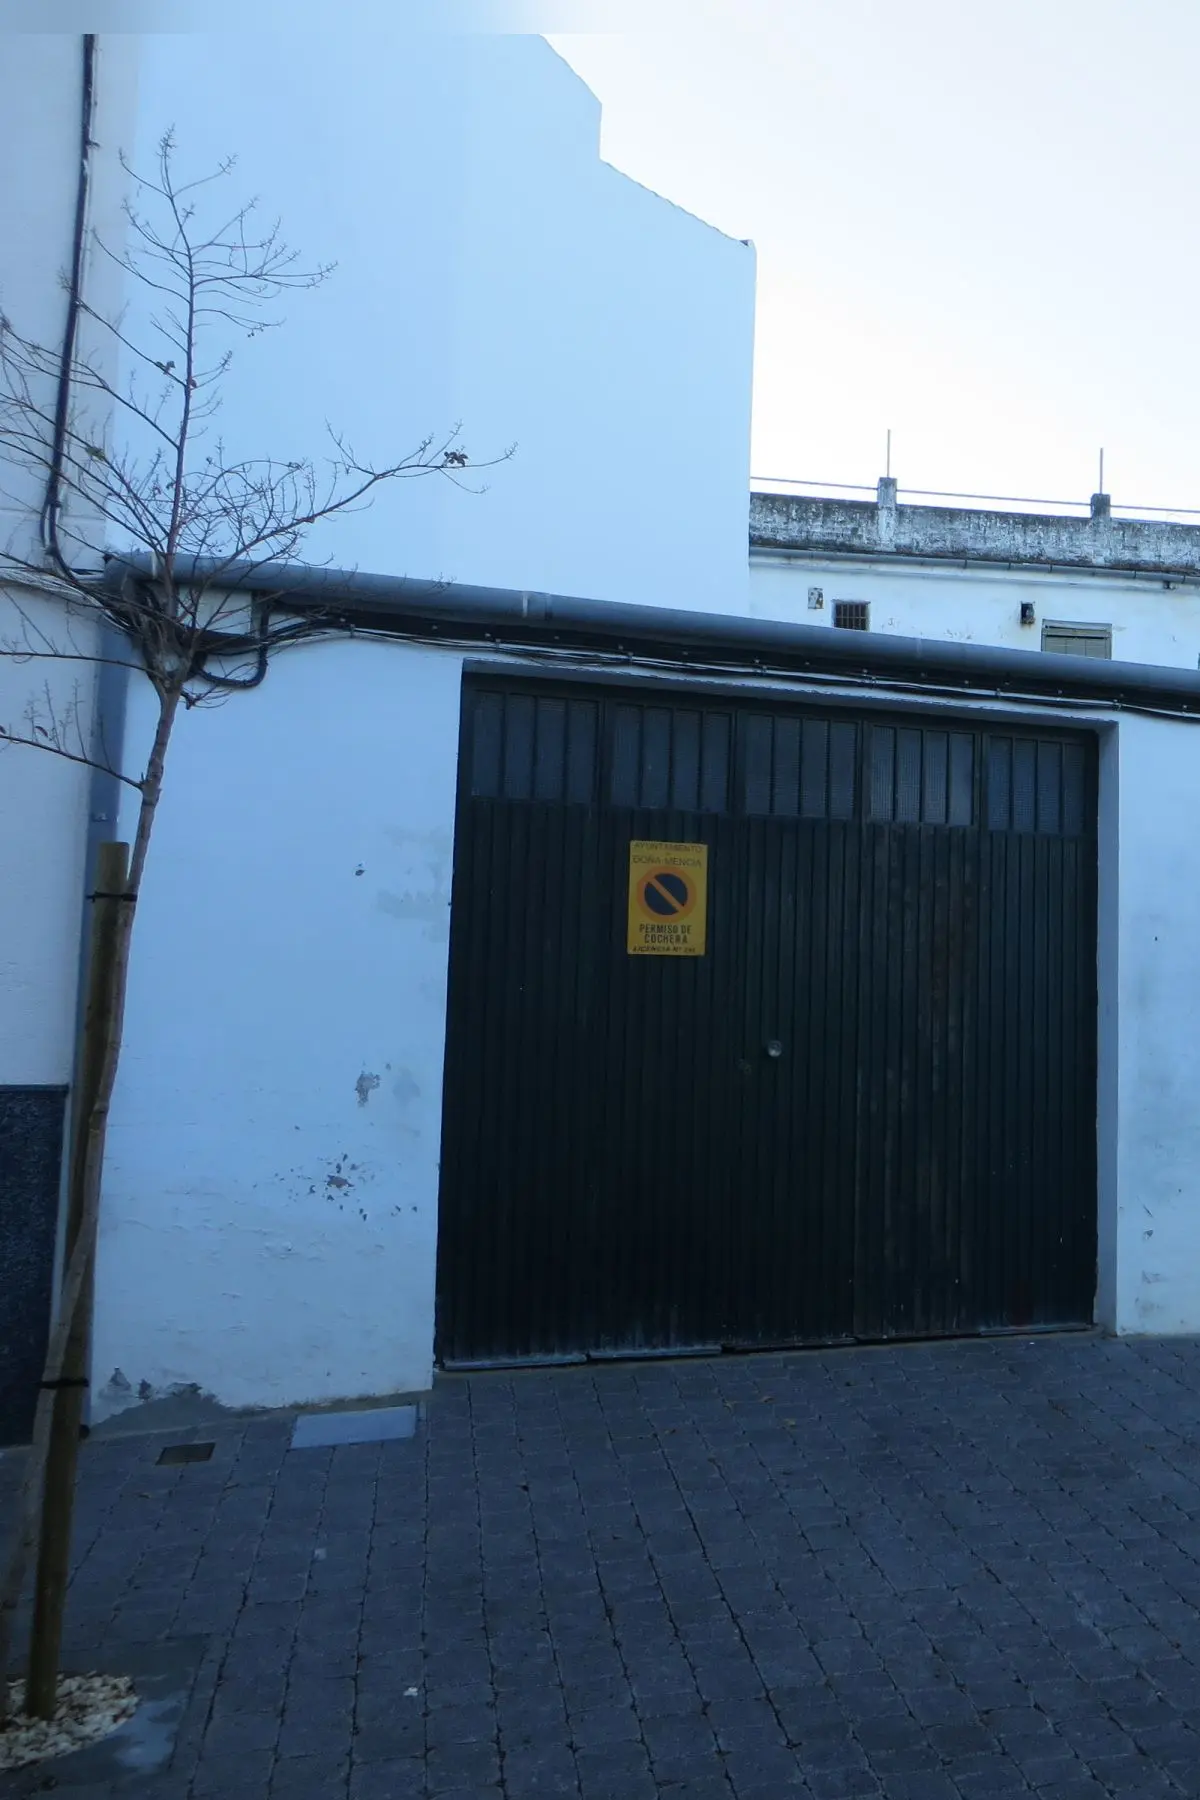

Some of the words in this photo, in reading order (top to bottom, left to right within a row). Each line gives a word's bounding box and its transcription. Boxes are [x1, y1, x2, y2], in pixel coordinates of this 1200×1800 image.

[639, 923, 679, 934] PERMISO
[681, 925, 692, 935] DE
[644, 934, 688, 944] COCHERA
